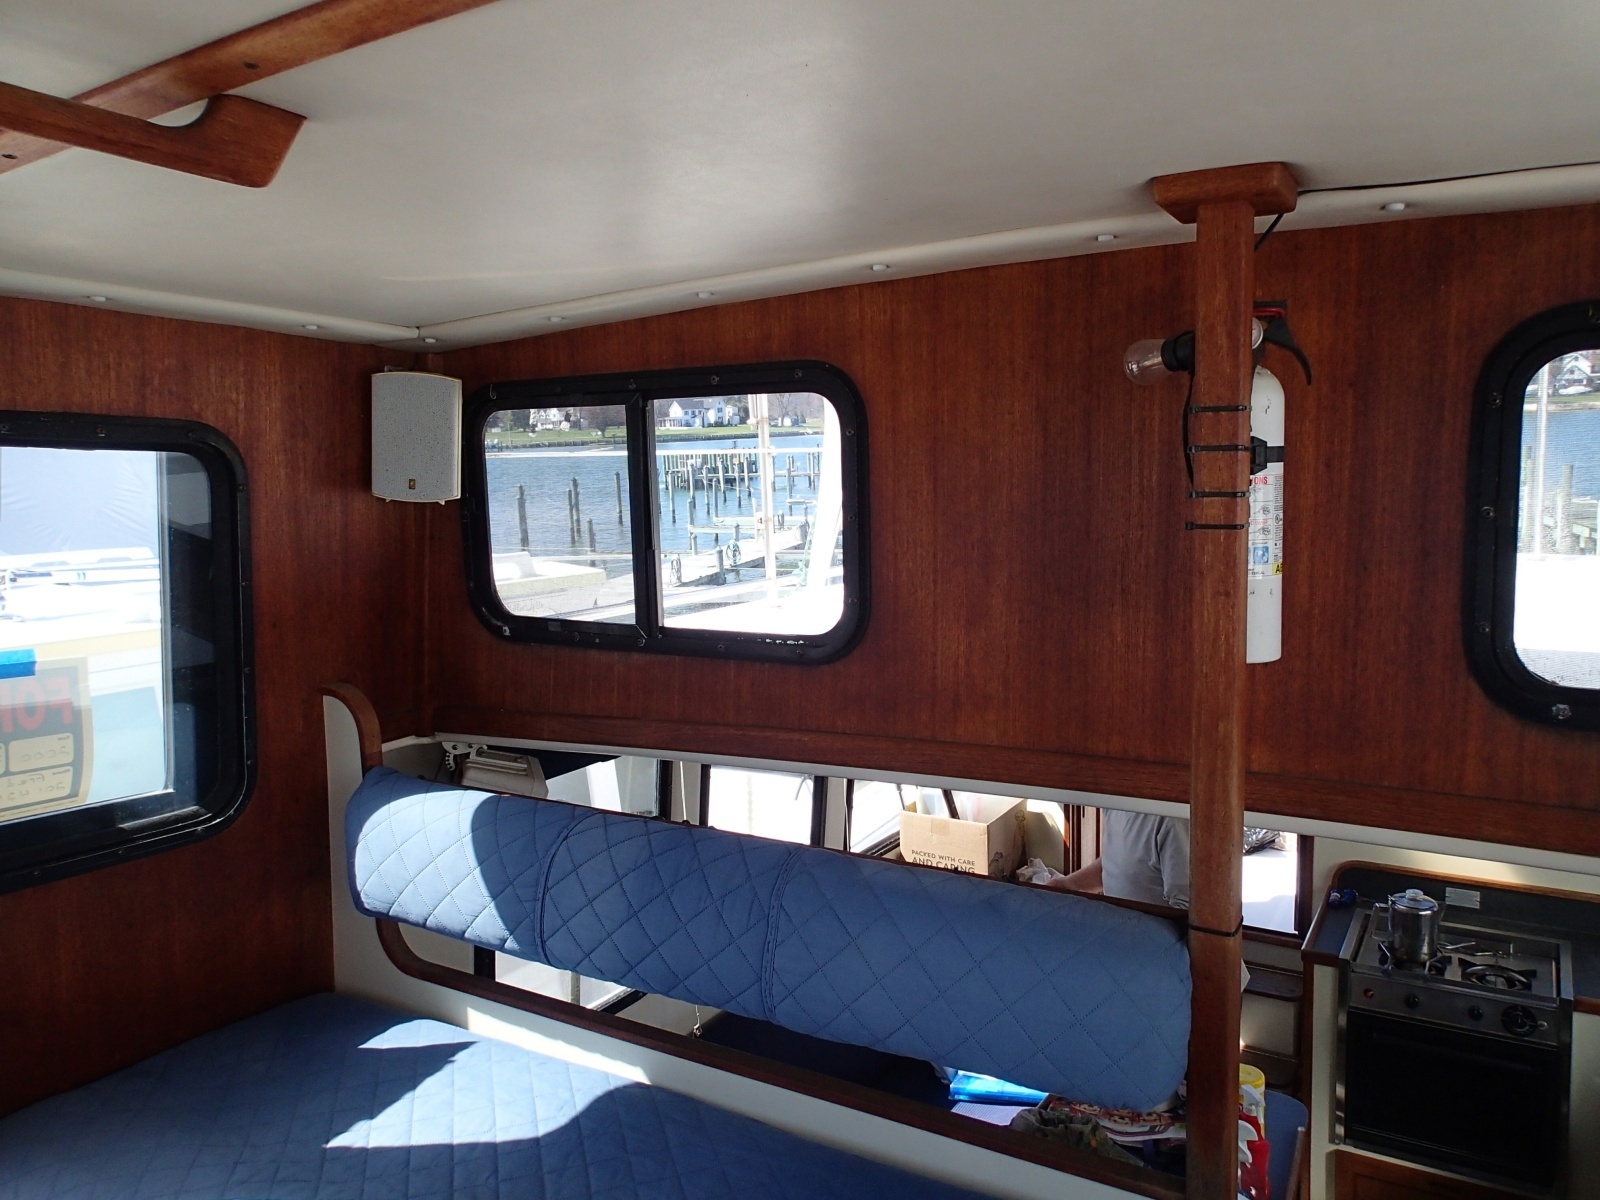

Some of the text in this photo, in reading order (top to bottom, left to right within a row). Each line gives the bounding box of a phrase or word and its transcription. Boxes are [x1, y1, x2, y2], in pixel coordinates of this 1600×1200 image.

[911, 849, 976, 866] PACKED WITH CARE
[912, 857, 933, 867] AND
